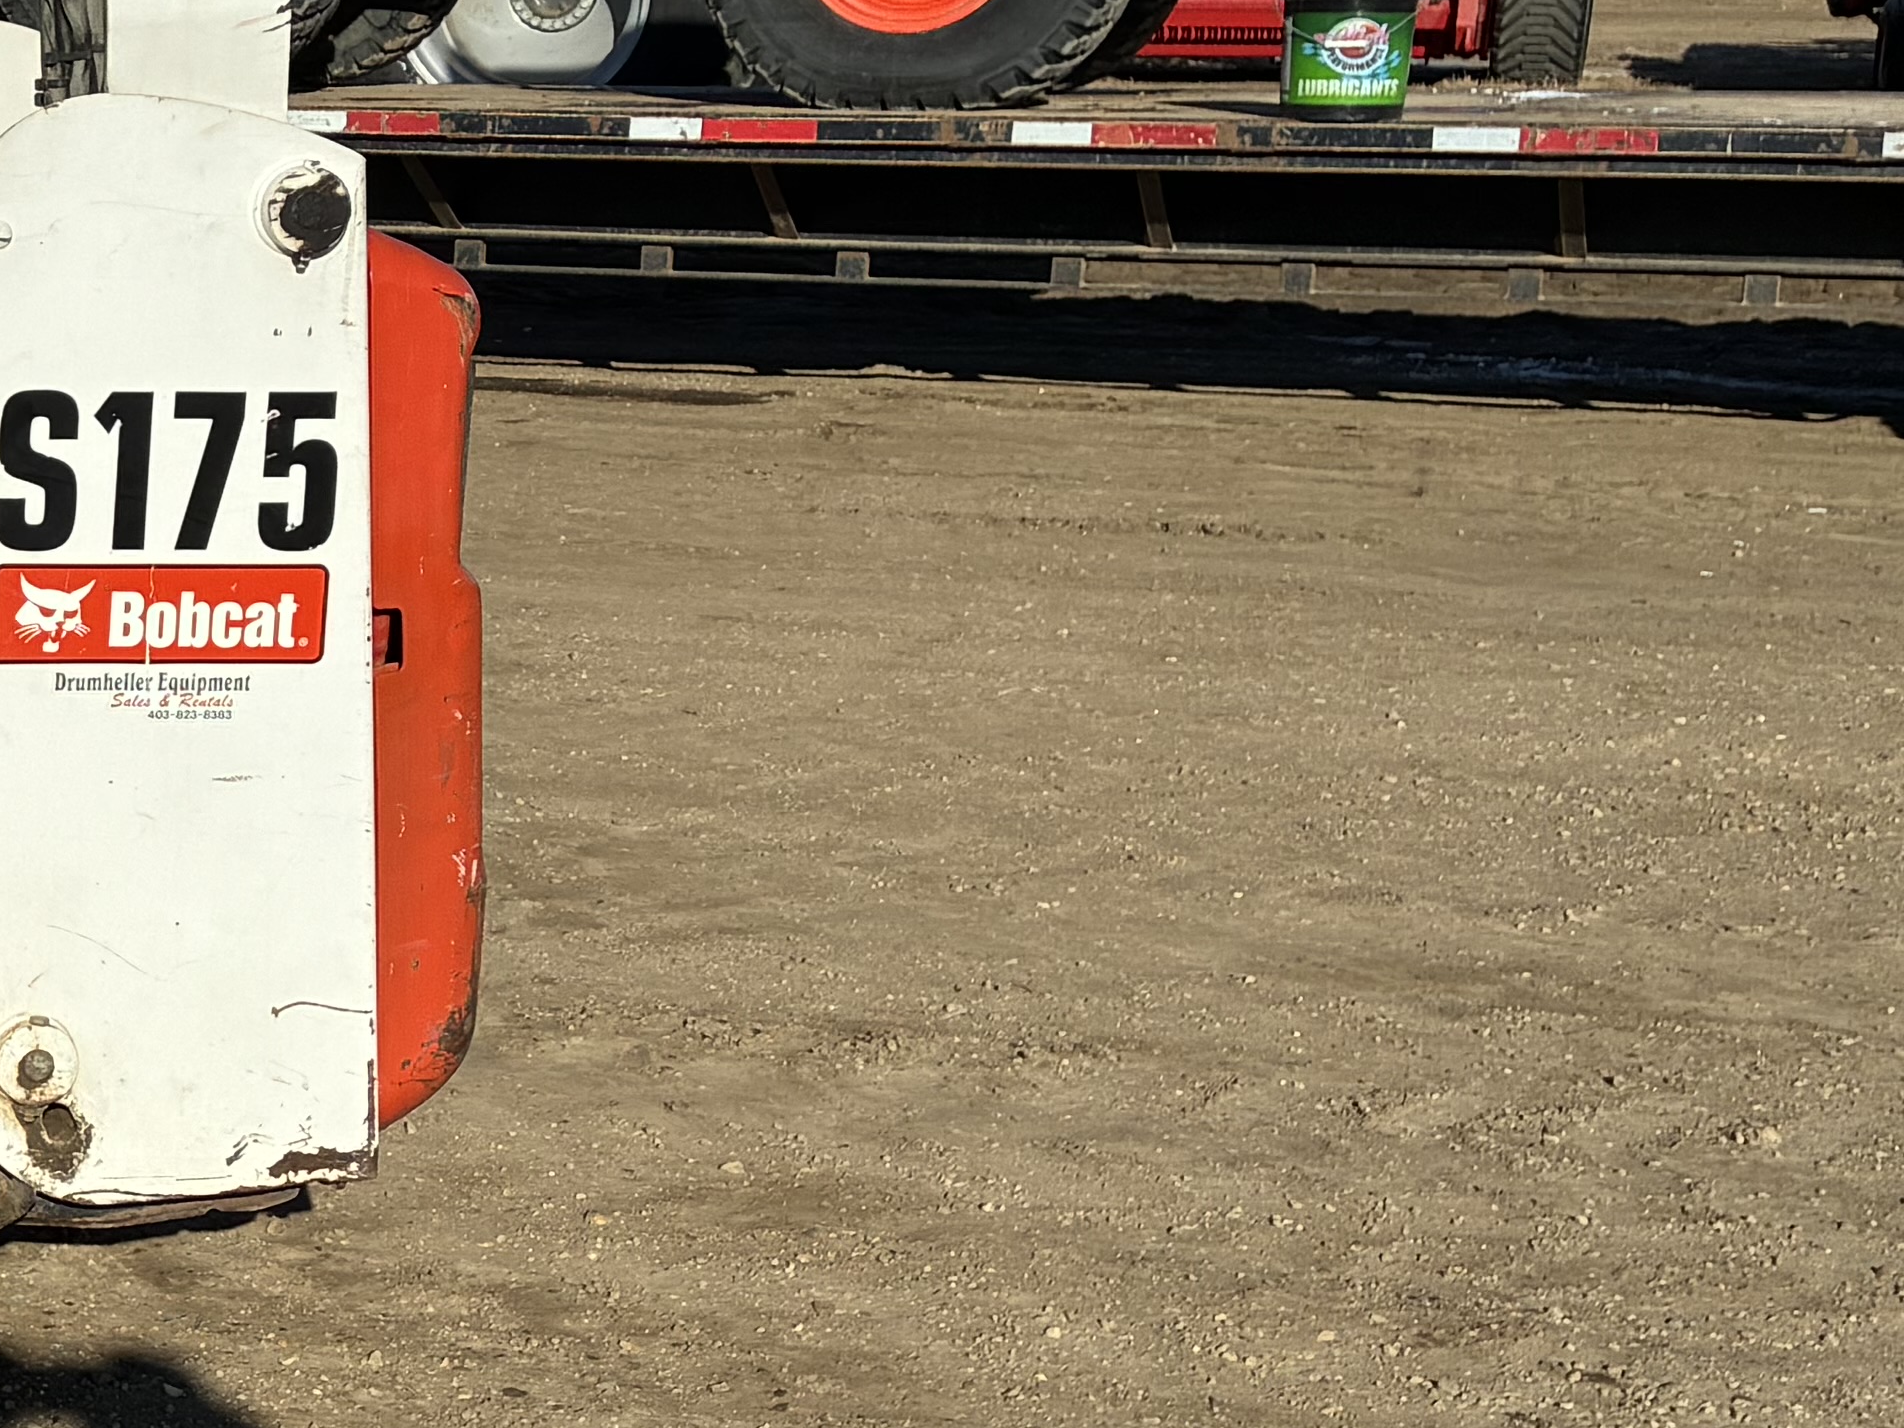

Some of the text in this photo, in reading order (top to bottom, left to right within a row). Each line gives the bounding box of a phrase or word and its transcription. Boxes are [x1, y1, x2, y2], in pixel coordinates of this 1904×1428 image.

[1297, 78, 1400, 98] LUBRICANTS
[108, 590, 301, 649] Bobcat
[54, 672, 251, 696] Drumheller Equipment
[110, 692, 234, 708] Sales & Rentals
[147, 709, 233, 720] 403-823-8383
